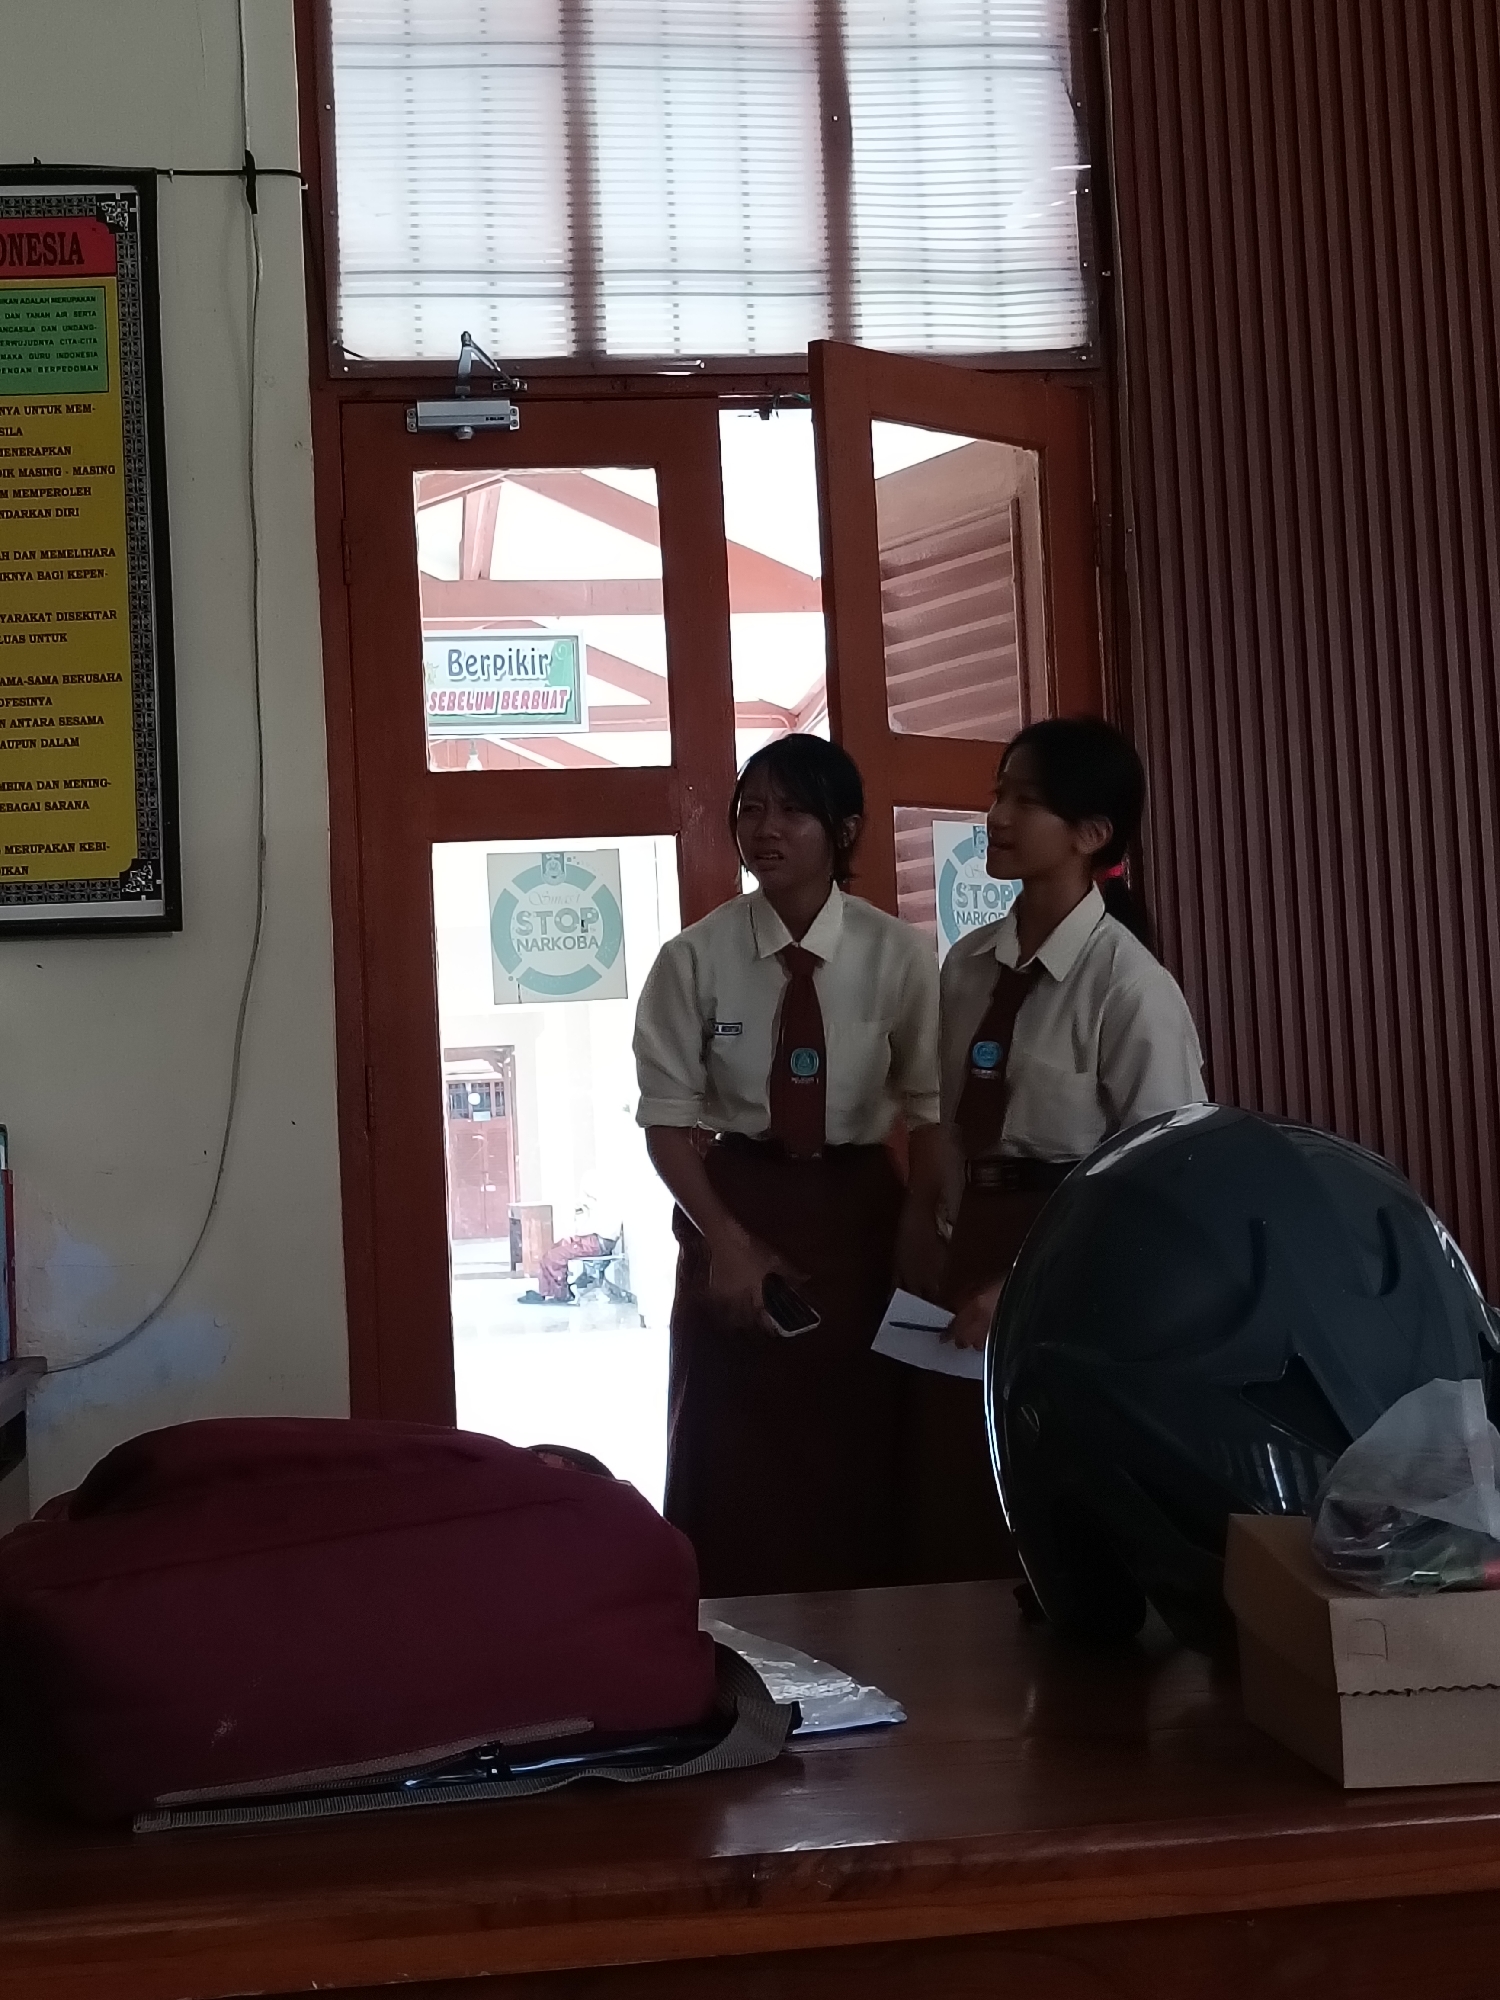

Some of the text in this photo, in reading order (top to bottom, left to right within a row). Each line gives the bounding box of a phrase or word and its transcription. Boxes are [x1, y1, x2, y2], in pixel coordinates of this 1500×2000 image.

[38, 365, 98, 373] BERPEDOMAN
[24, 405, 62, 415] UNTUK
[66, 404, 96, 413] MEM-
[19, 467, 62, 477] MASING
[73, 465, 115, 475] MASING
[13, 487, 91, 498] MEMPEROLEH
[55, 508, 79, 517] DIRI
[14, 551, 36, 560] DAN
[40, 548, 116, 559] MEMELIHARA
[37, 571, 64, 580] BAGI
[68, 569, 108, 579] KEPEN-
[56, 610, 117, 621] DISEKITAR
[29, 633, 68, 643] UNTUK
[448, 648, 549, 677] Berpikir
[62, 673, 123, 684] BERUSAHA
[429, 689, 568, 712] SEBELUM BERBUAT
[10, 718, 55, 728] ANTARA
[59, 716, 104, 726] SESAMA
[41, 737, 79, 747] DALAM
[37, 780, 59, 790] DAN
[64, 779, 112, 789] MENING-
[45, 801, 90, 811] SARANA
[5, 842, 110, 854] MERUPAKAN KEBI-
[0, 866, 29, 876] IKAN
[955, 882, 1014, 910] STOP
[515, 907, 600, 937] STOP
[956, 910, 1005, 926] NARKO
[516, 935, 599, 953] NARKOBA
